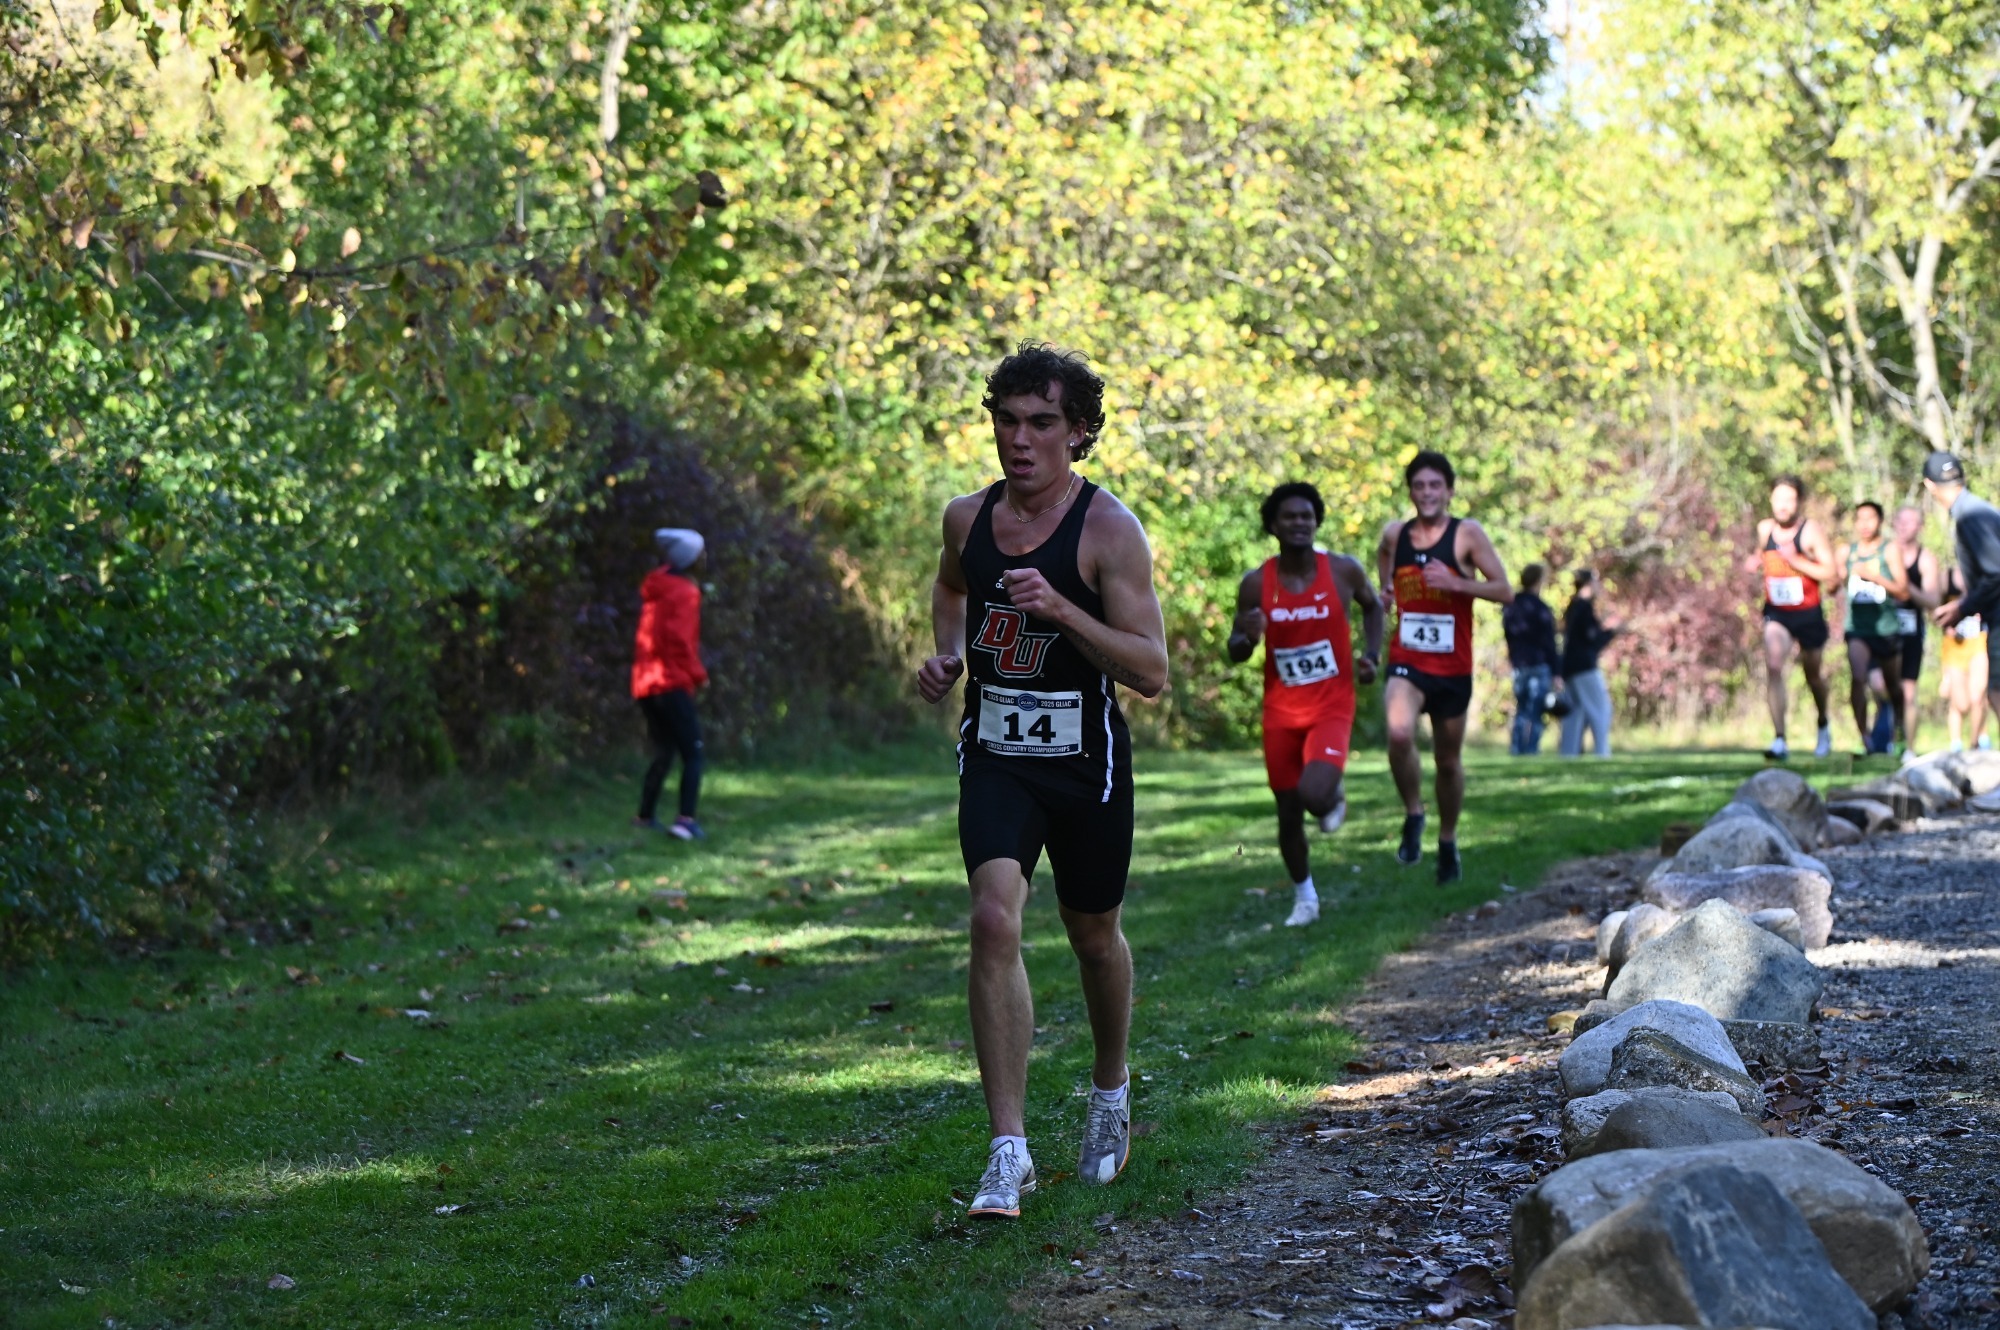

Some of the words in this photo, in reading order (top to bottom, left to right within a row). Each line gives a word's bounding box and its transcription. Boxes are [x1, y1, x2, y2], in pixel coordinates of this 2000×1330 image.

[1270, 605, 1329, 622] SVSU
[971, 602, 1060, 679] DU
[1413, 627, 1440, 643] 43
[1285, 655, 1328, 677] 194
[987, 692, 999, 702] 2025
[999, 696, 1015, 704] GLIAC
[1055, 700, 1072, 708] GLIAC
[1003, 711, 1057, 744] 14
[987, 742, 1002, 751] CROSS
[1003, 745, 1026, 753] COUNTRY
[1027, 745, 1070, 754] CHAMPIONSHIPS
